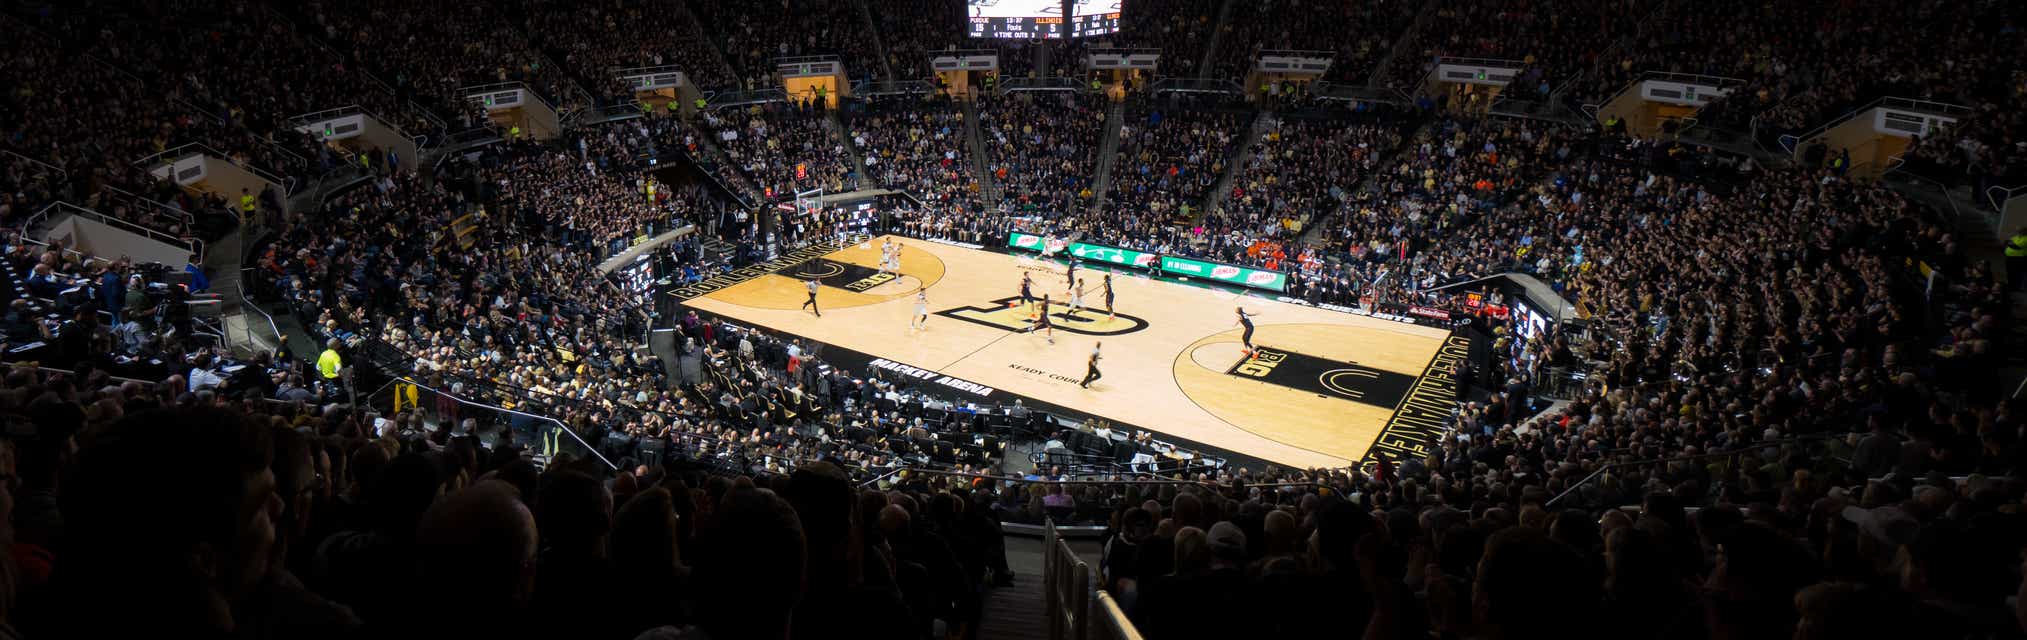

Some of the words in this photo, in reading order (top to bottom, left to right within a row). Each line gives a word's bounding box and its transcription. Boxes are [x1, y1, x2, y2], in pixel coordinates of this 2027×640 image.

[868, 358, 939, 380] MACKEY
[934, 376, 995, 397] ARENA
[1008, 363, 1046, 376] KEADY
[1049, 373, 1080, 385] COUR
